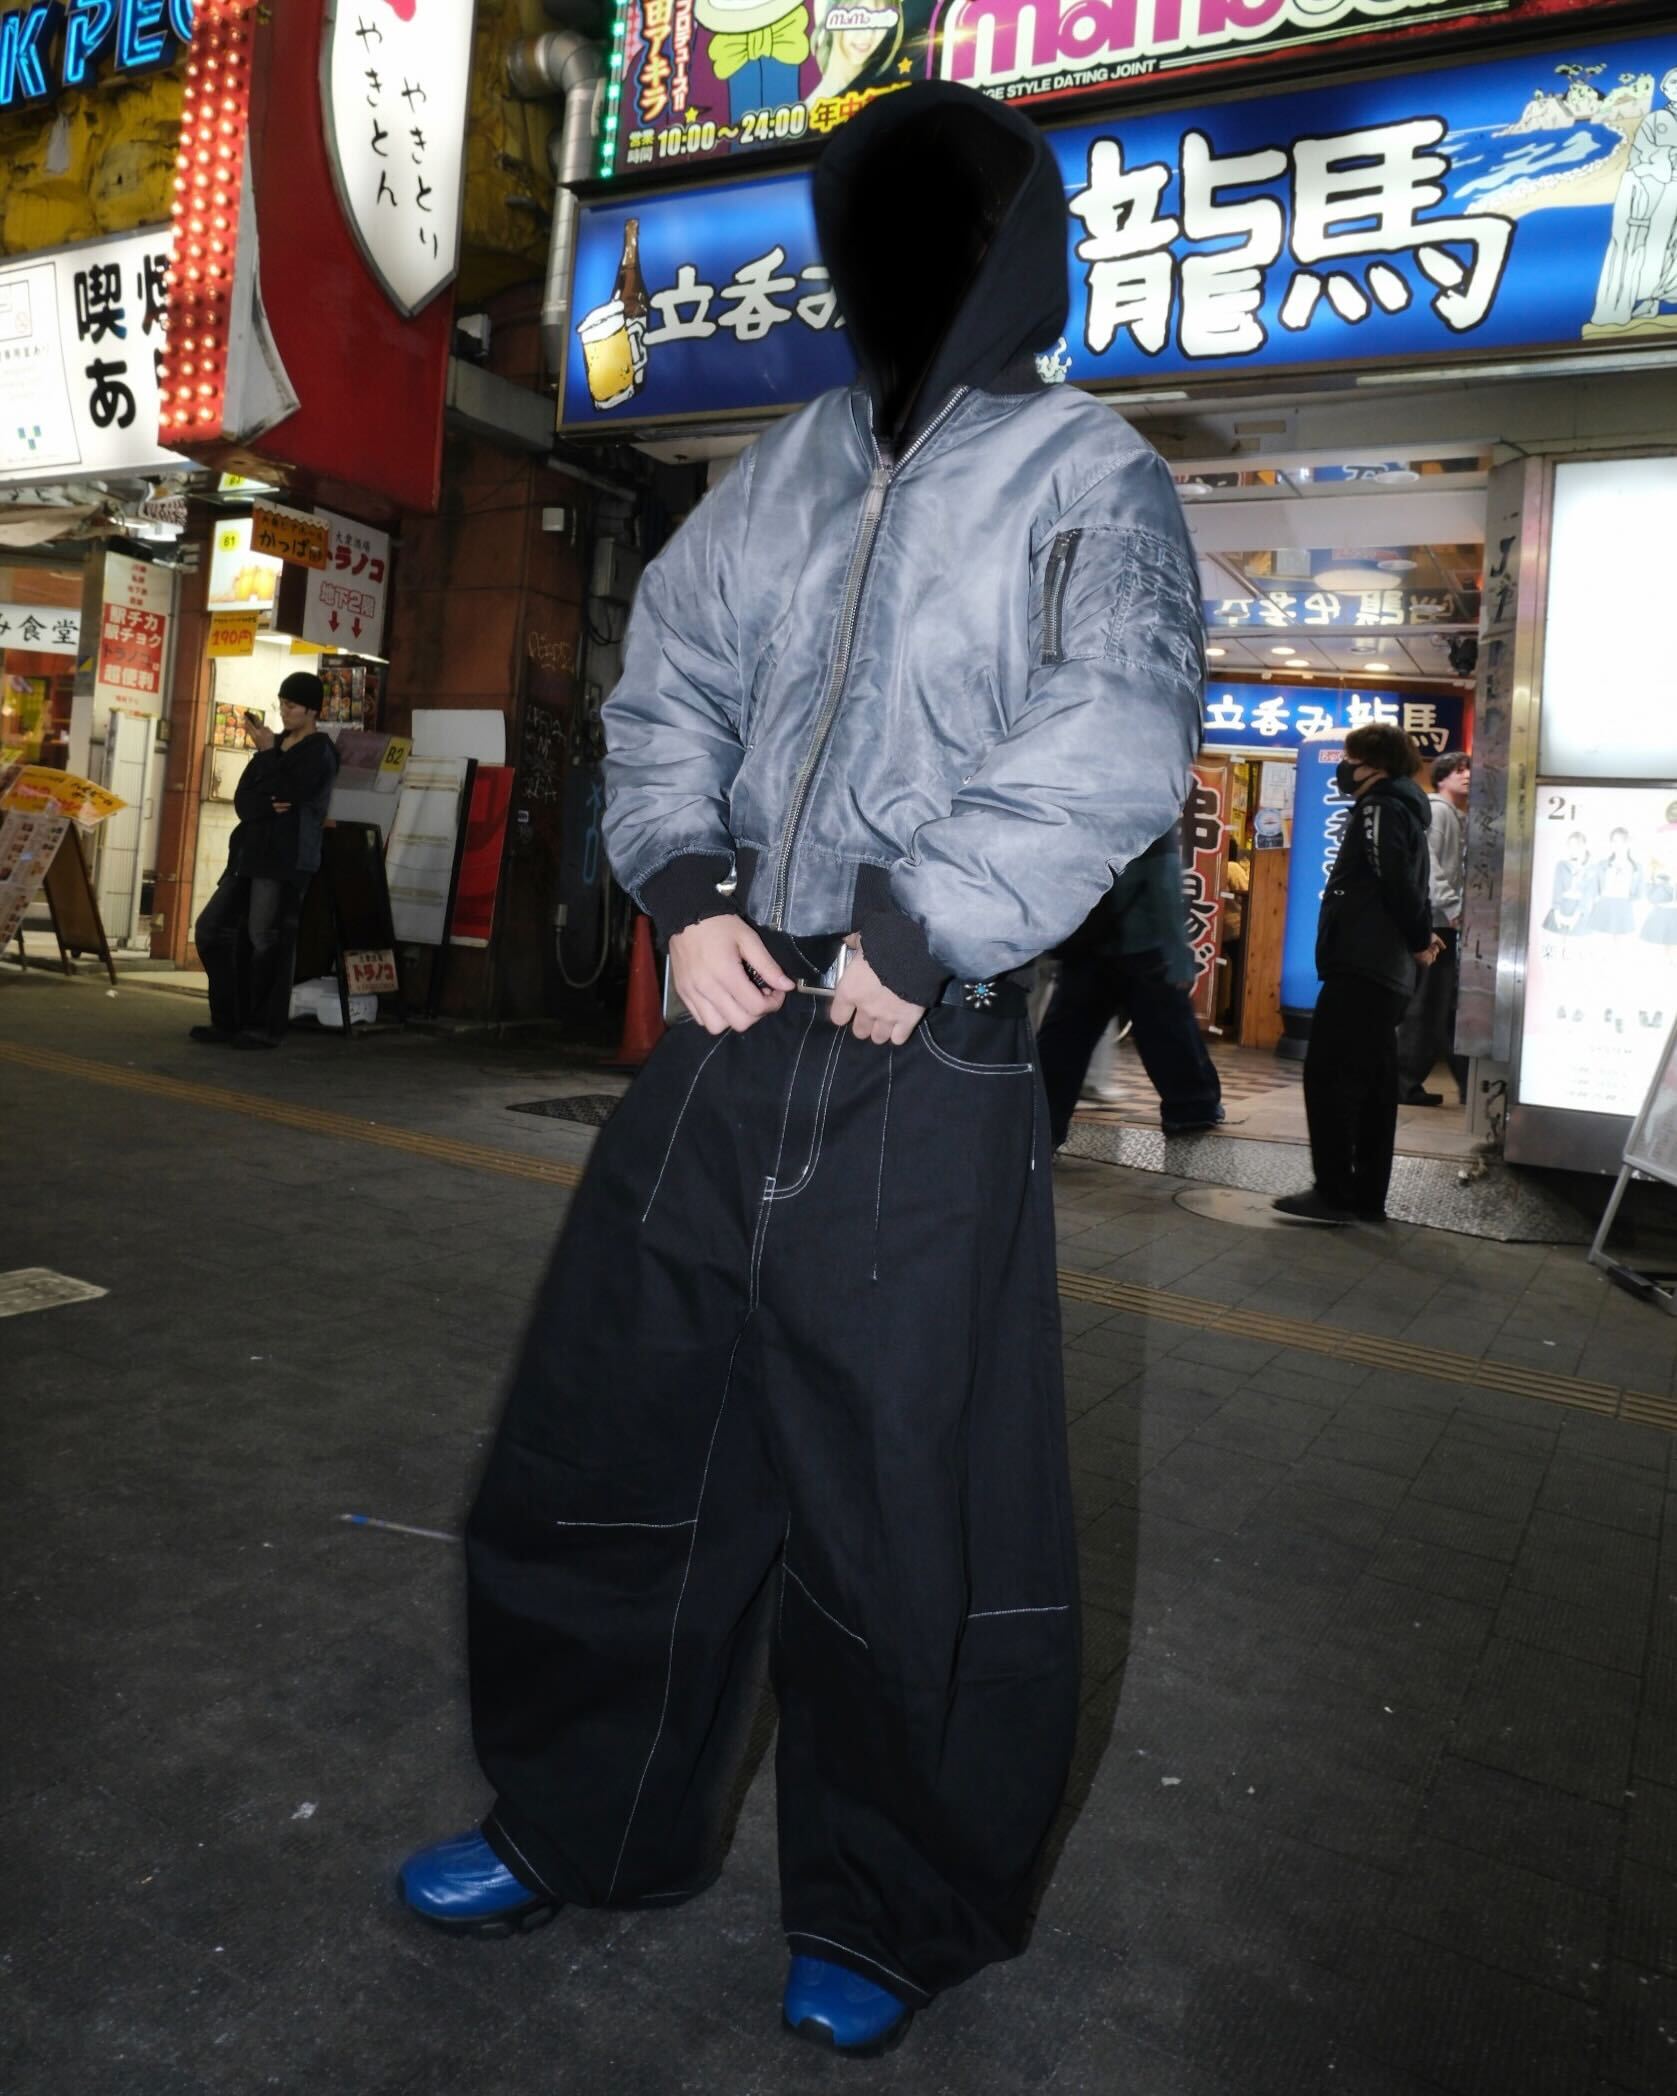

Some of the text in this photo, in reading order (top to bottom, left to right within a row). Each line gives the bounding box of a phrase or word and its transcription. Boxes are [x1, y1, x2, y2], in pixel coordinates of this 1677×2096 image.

[355, 16, 397, 207] やきとん
[1006, 78, 1051, 98] STYLE
[1053, 68, 1109, 89] DATING
[1110, 59, 1157, 80] JOINT
[401, 77, 438, 259] やきとり
[1067, 116, 1516, 359] 龍馬
[327, 545, 385, 584] ラノコ
[385, 746, 404, 765] B2
